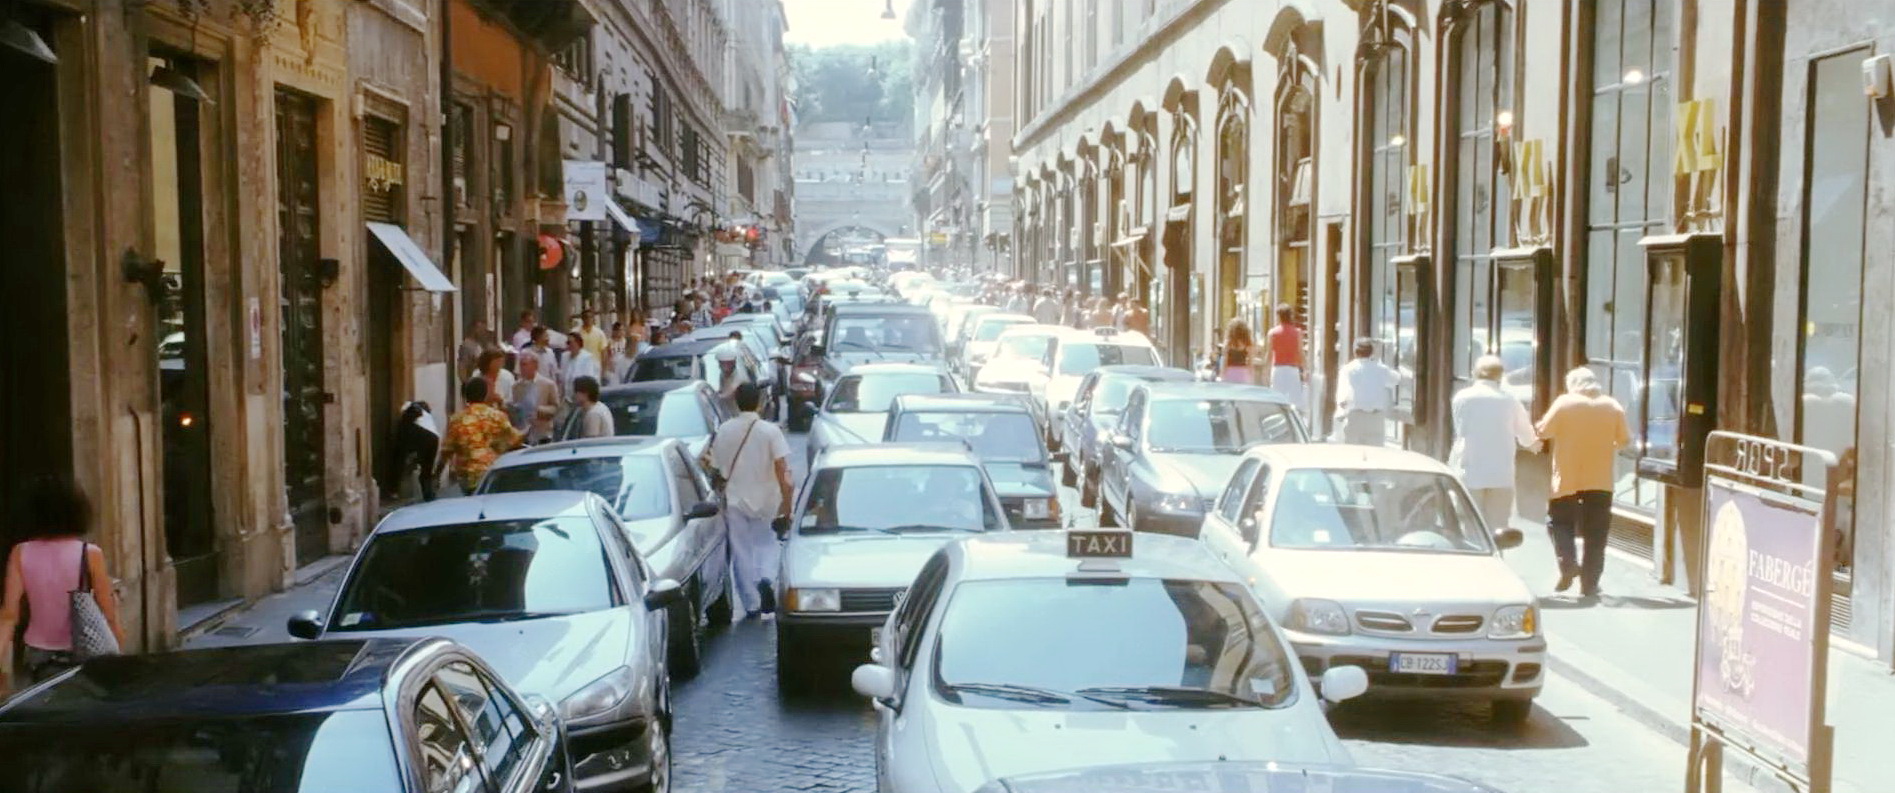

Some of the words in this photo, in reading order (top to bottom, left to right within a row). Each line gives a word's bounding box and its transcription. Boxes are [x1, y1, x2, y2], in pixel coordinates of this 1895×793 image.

[1675, 98, 1723, 174] XL
[1405, 164, 1431, 215] XL
[1513, 138, 1550, 200] XL
[1071, 535, 1127, 553] TAXI
[1748, 548, 1811, 598] FABERGÉ
